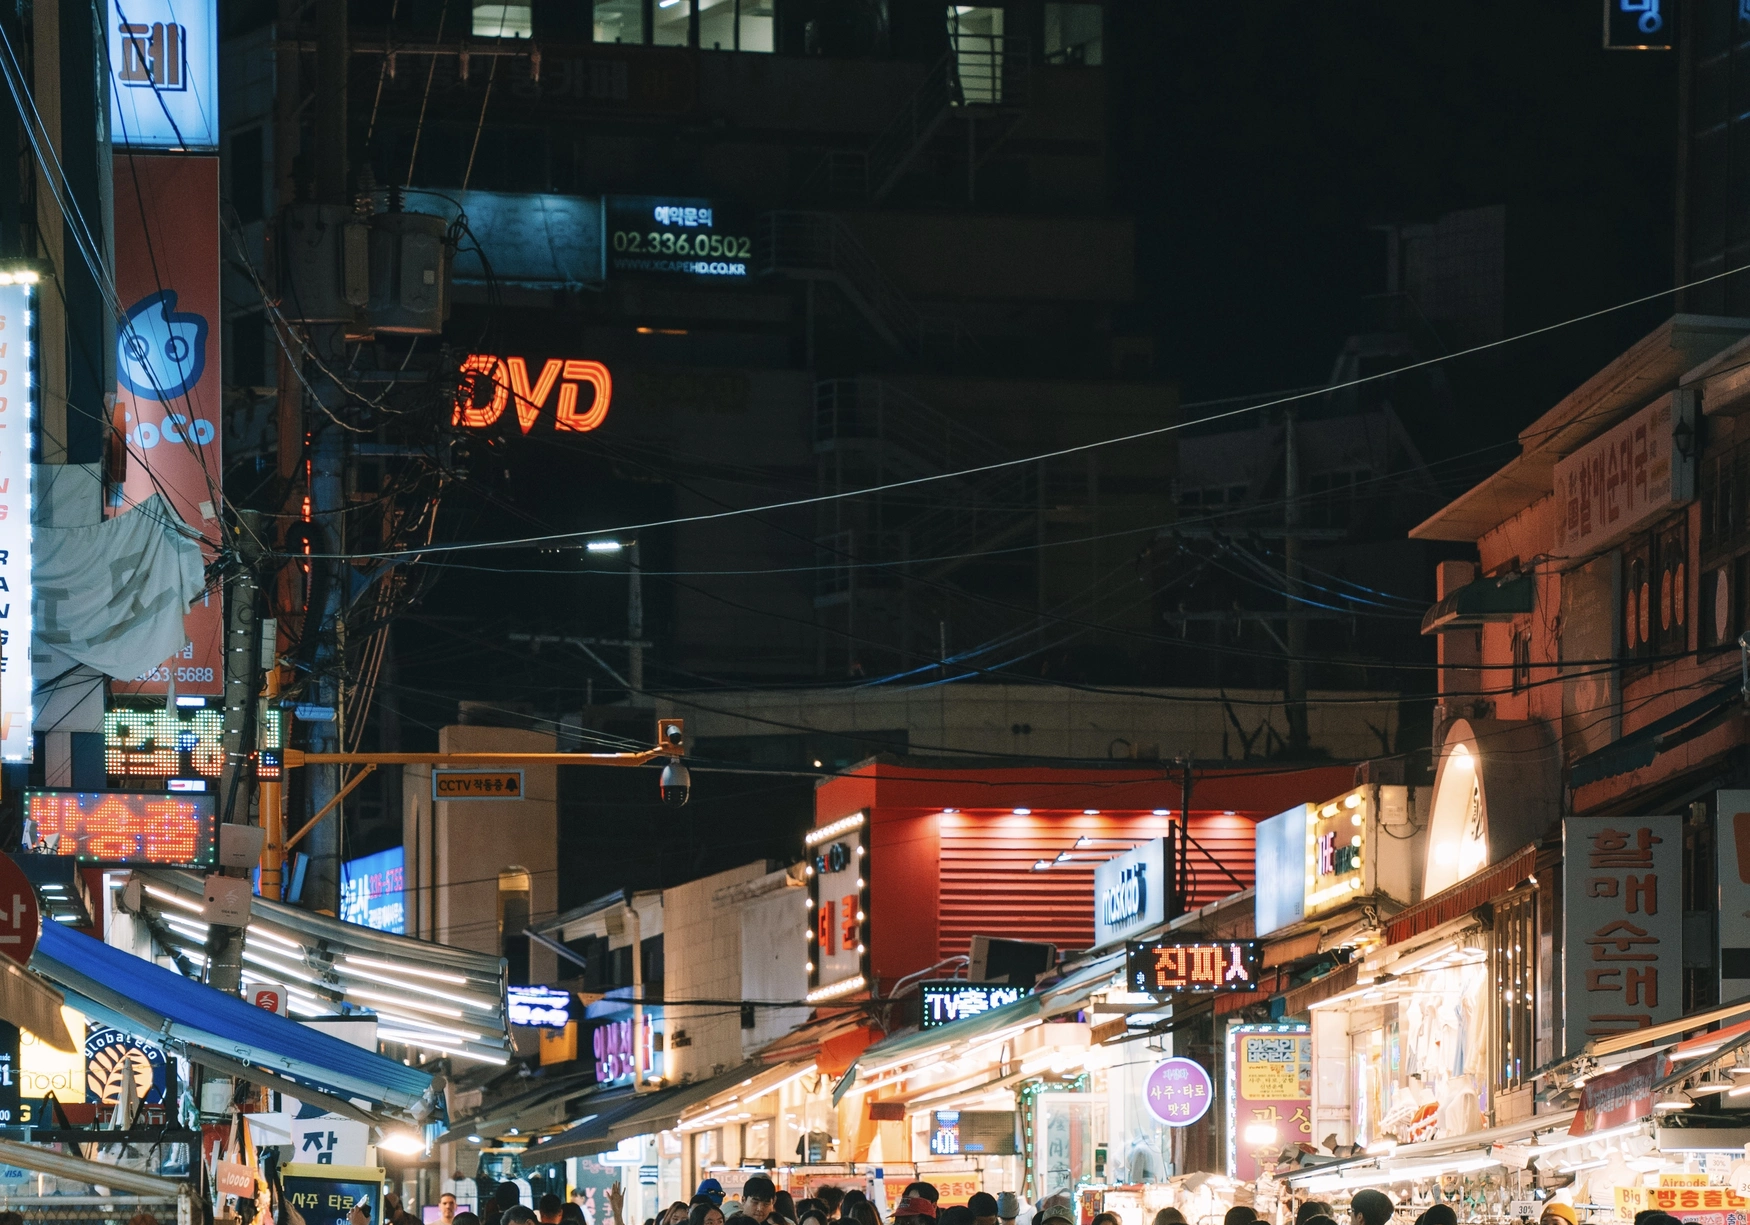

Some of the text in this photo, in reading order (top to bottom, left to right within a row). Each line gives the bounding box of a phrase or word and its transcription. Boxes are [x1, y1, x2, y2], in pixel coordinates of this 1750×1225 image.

[613, 231, 751, 258] 02.336.0502
[451, 353, 612, 436] DVD
[439, 780, 471, 791] CCTV
[84, 1032, 158, 1060] global eco
[1168, 1102, 1190, 1117] 맛집
[4, 1170, 23, 1178] VISA
[932, 1181, 977, 1197] 송출연
[1622, 1189, 1641, 1206] Big
[292, 1192, 319, 1210] 사주
[1657, 1189, 1747, 1209] 방송출연
[1518, 1205, 1534, 1215] 30%
